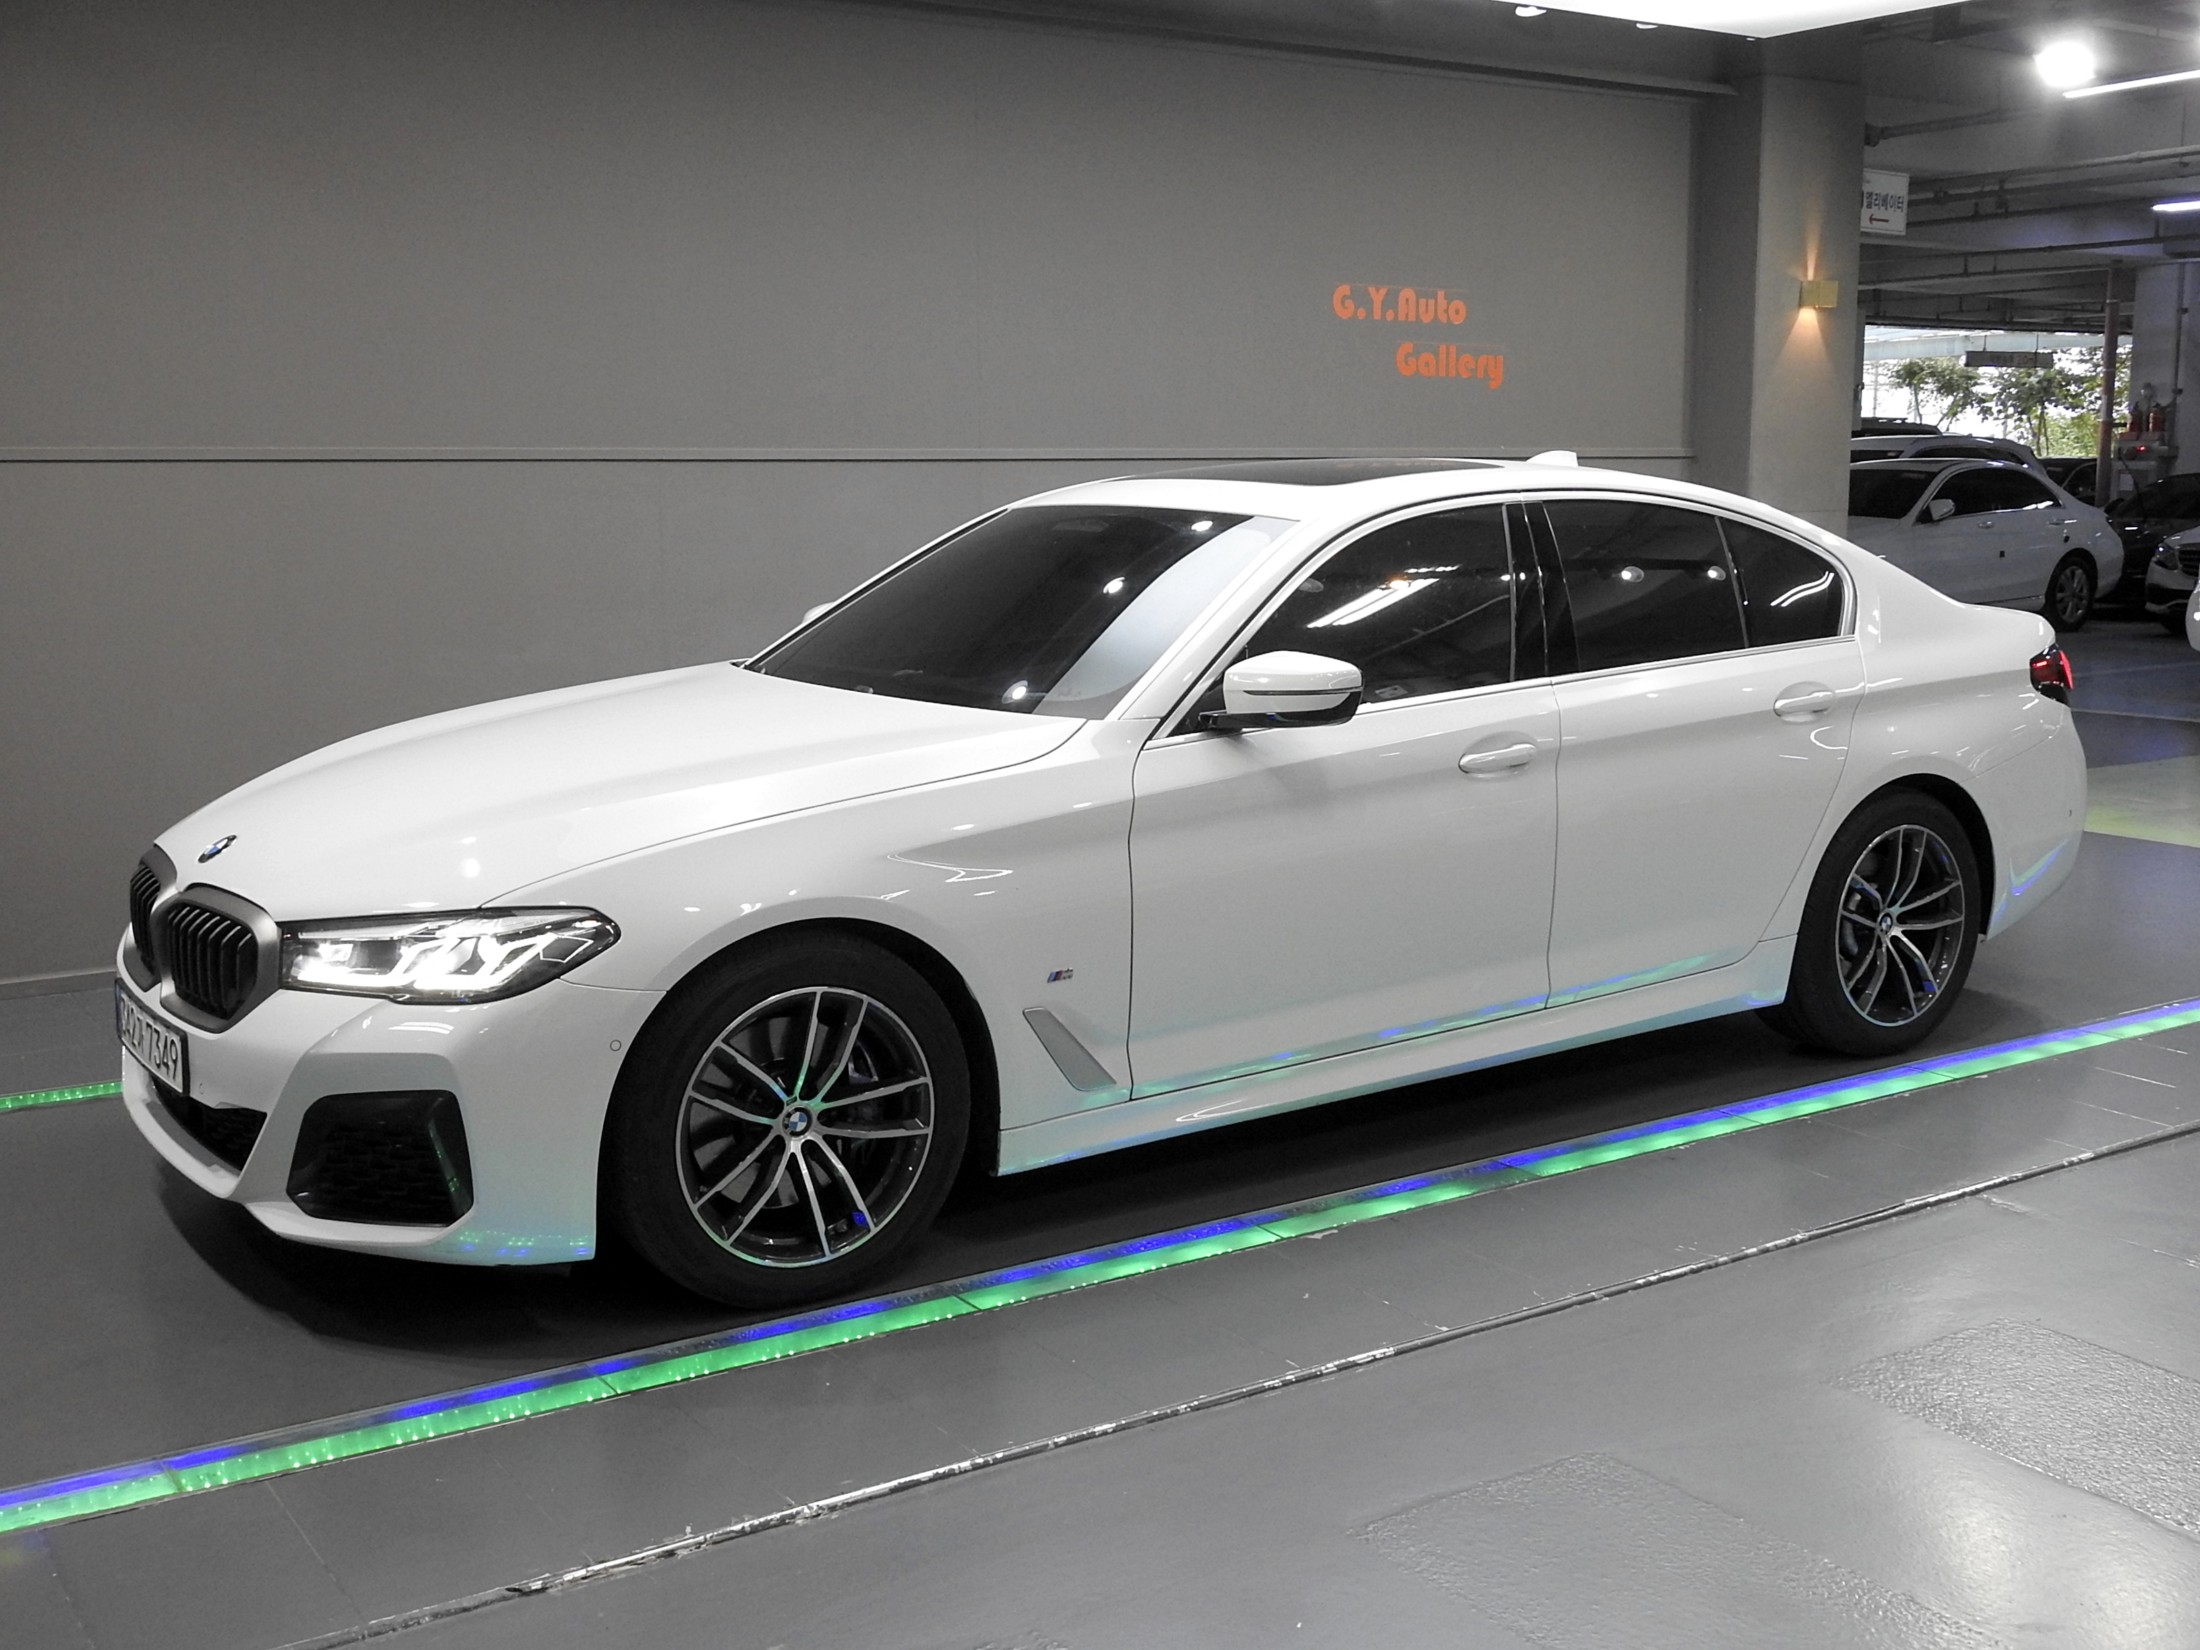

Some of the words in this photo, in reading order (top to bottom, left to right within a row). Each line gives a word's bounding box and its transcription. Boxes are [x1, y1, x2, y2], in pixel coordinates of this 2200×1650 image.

[1332, 284, 1467, 325] G.Y.Auto
[1395, 341, 1504, 390] Gallery
[146, 1020, 179, 1081] 7349
